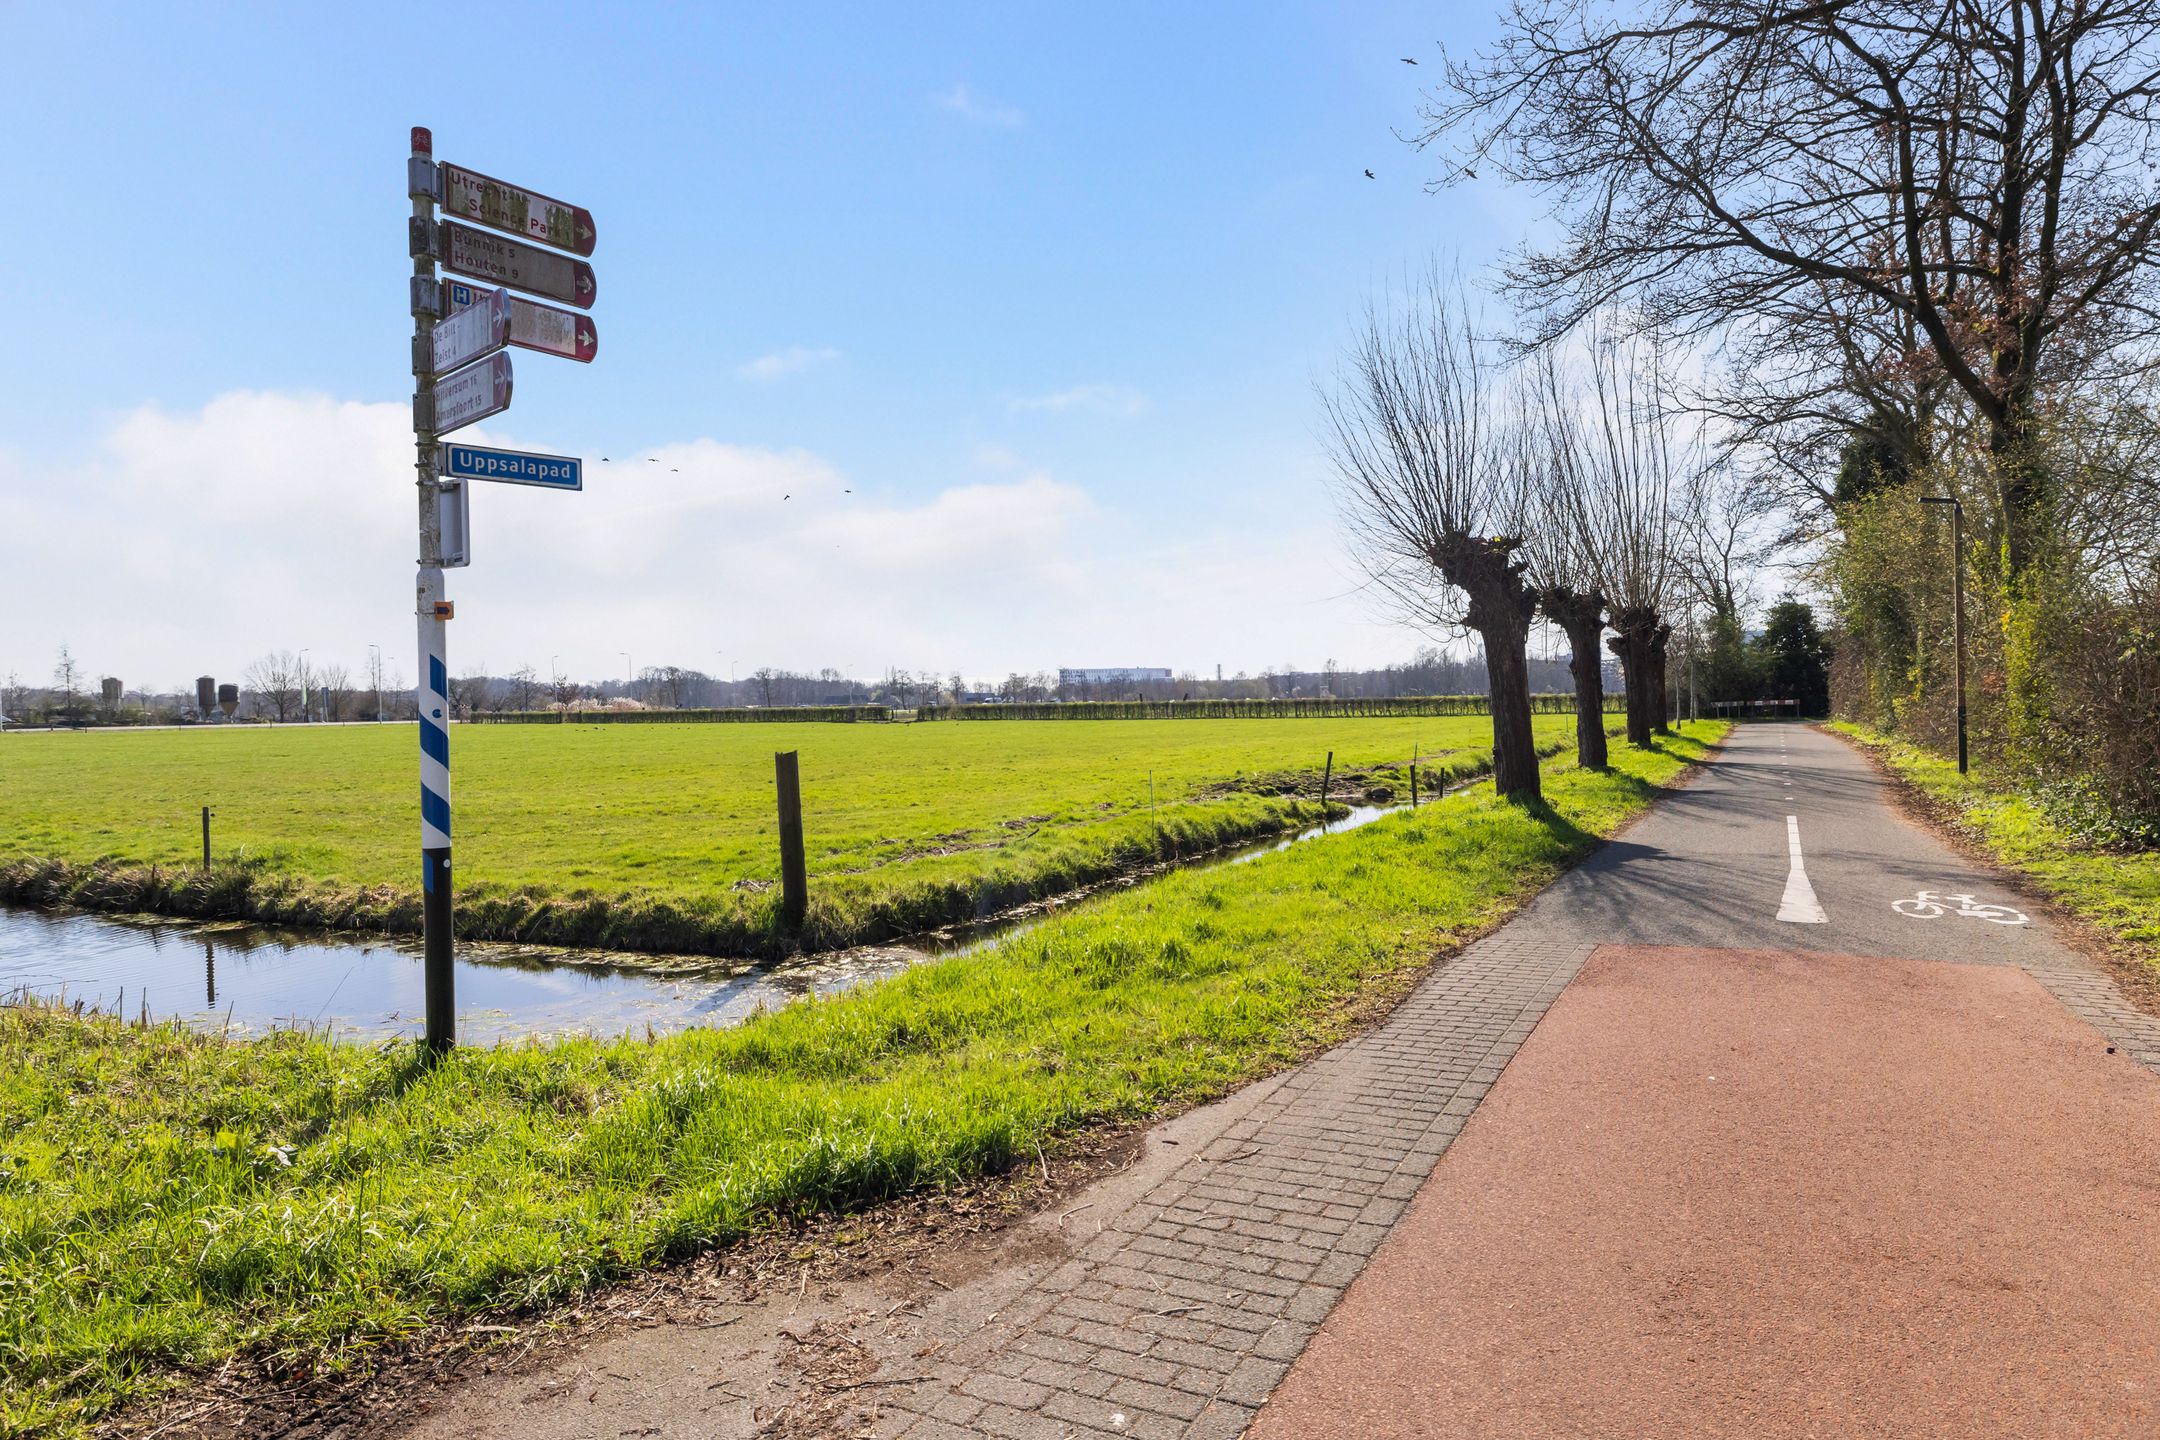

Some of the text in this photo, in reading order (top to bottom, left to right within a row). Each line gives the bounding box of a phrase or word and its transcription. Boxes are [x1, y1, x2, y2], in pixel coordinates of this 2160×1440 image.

[469, 198, 525, 226] Science
[454, 230, 504, 255] Bunnik
[455, 251, 519, 279] Houten 9
[457, 287, 467, 303] H
[434, 332, 442, 344] De
[444, 324, 456, 339] Bilt
[434, 345, 457, 365] Zeist 4
[435, 378, 468, 401] Hilversum
[436, 394, 482, 422] Amersfoort 15
[459, 451, 570, 480] Uppsalapad
